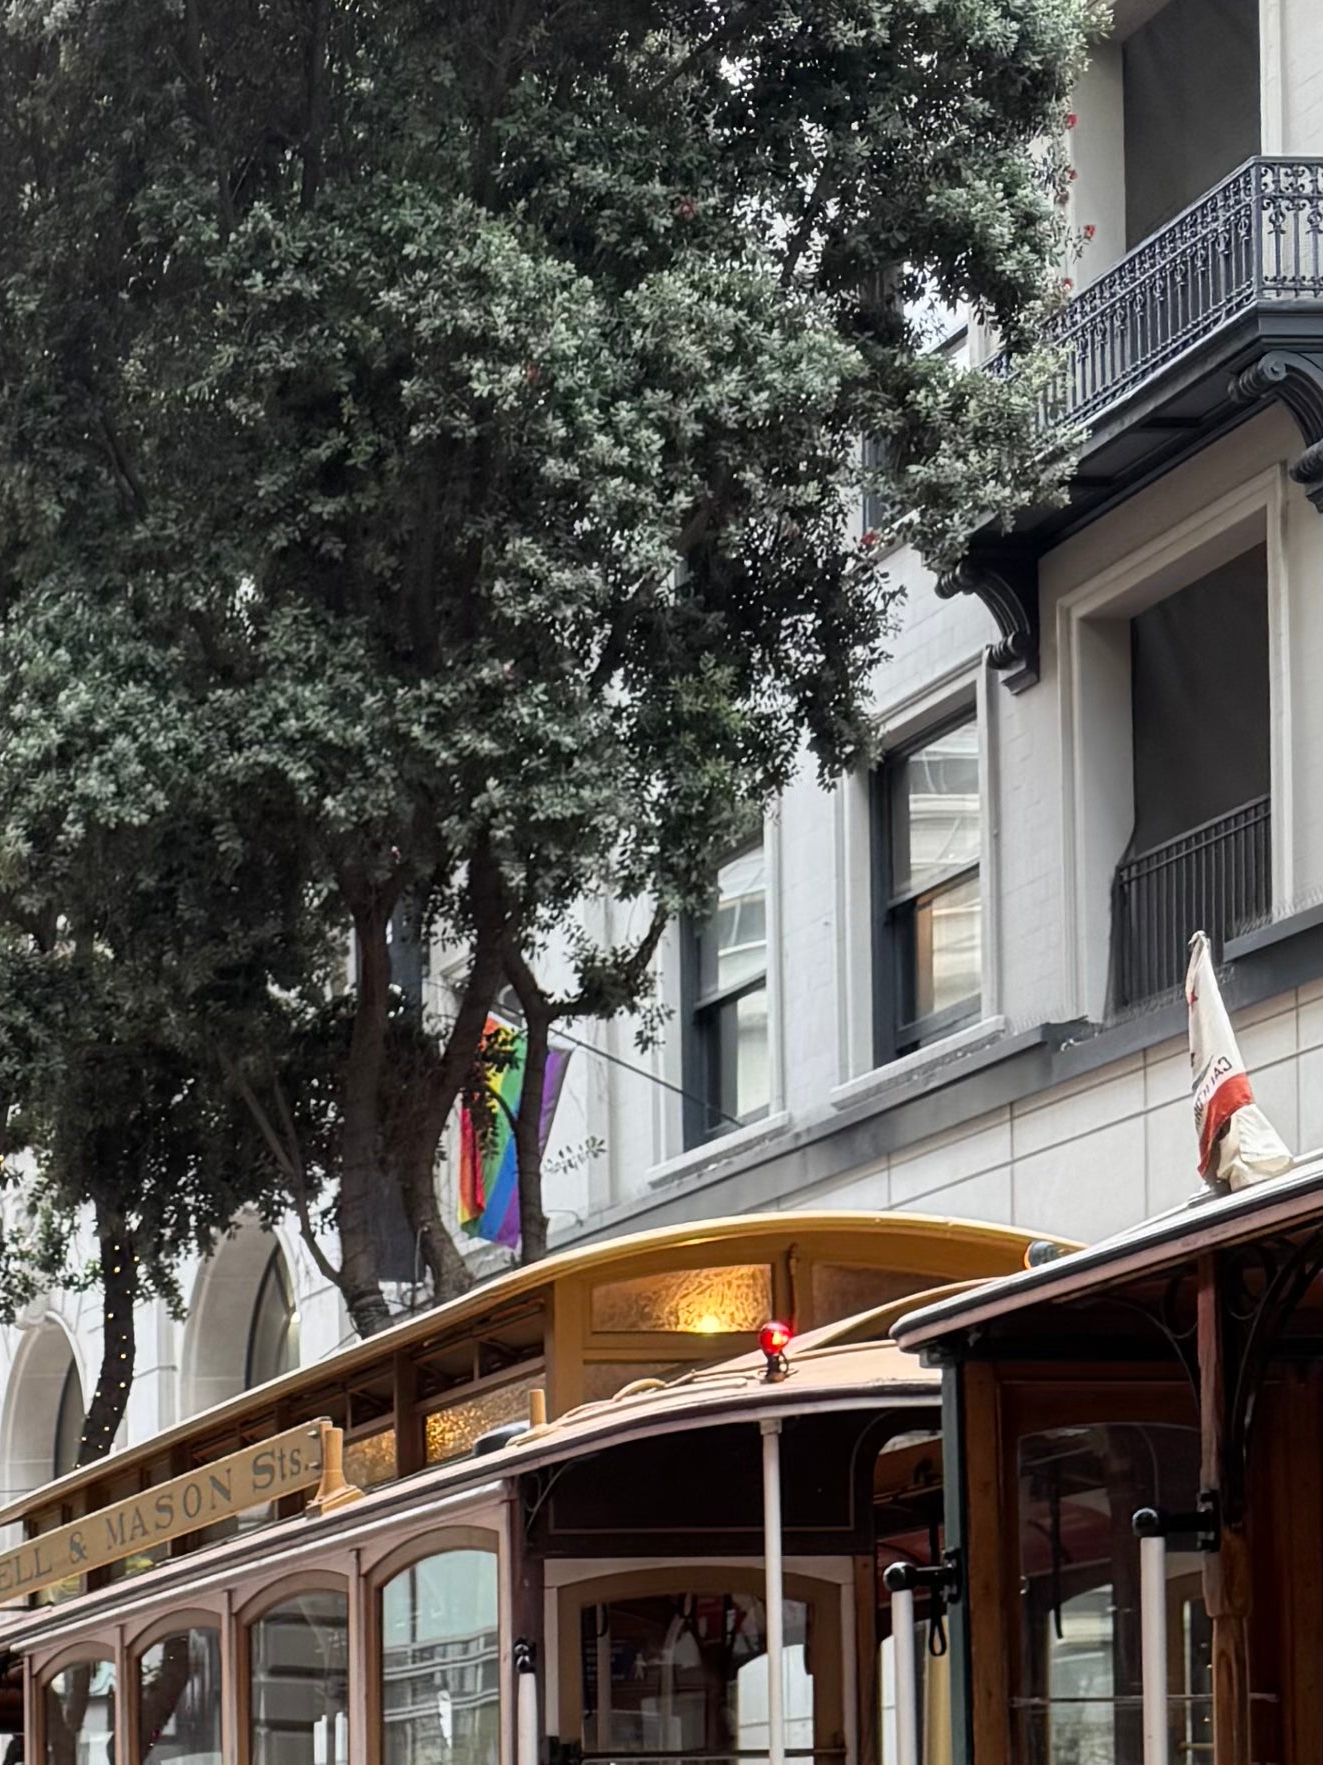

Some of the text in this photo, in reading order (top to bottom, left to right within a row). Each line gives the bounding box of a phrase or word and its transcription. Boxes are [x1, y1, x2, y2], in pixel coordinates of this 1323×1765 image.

[69, 1531, 88, 1565] &
[105, 1468, 232, 1551] MASON
[252, 1445, 312, 1492] Sts.
